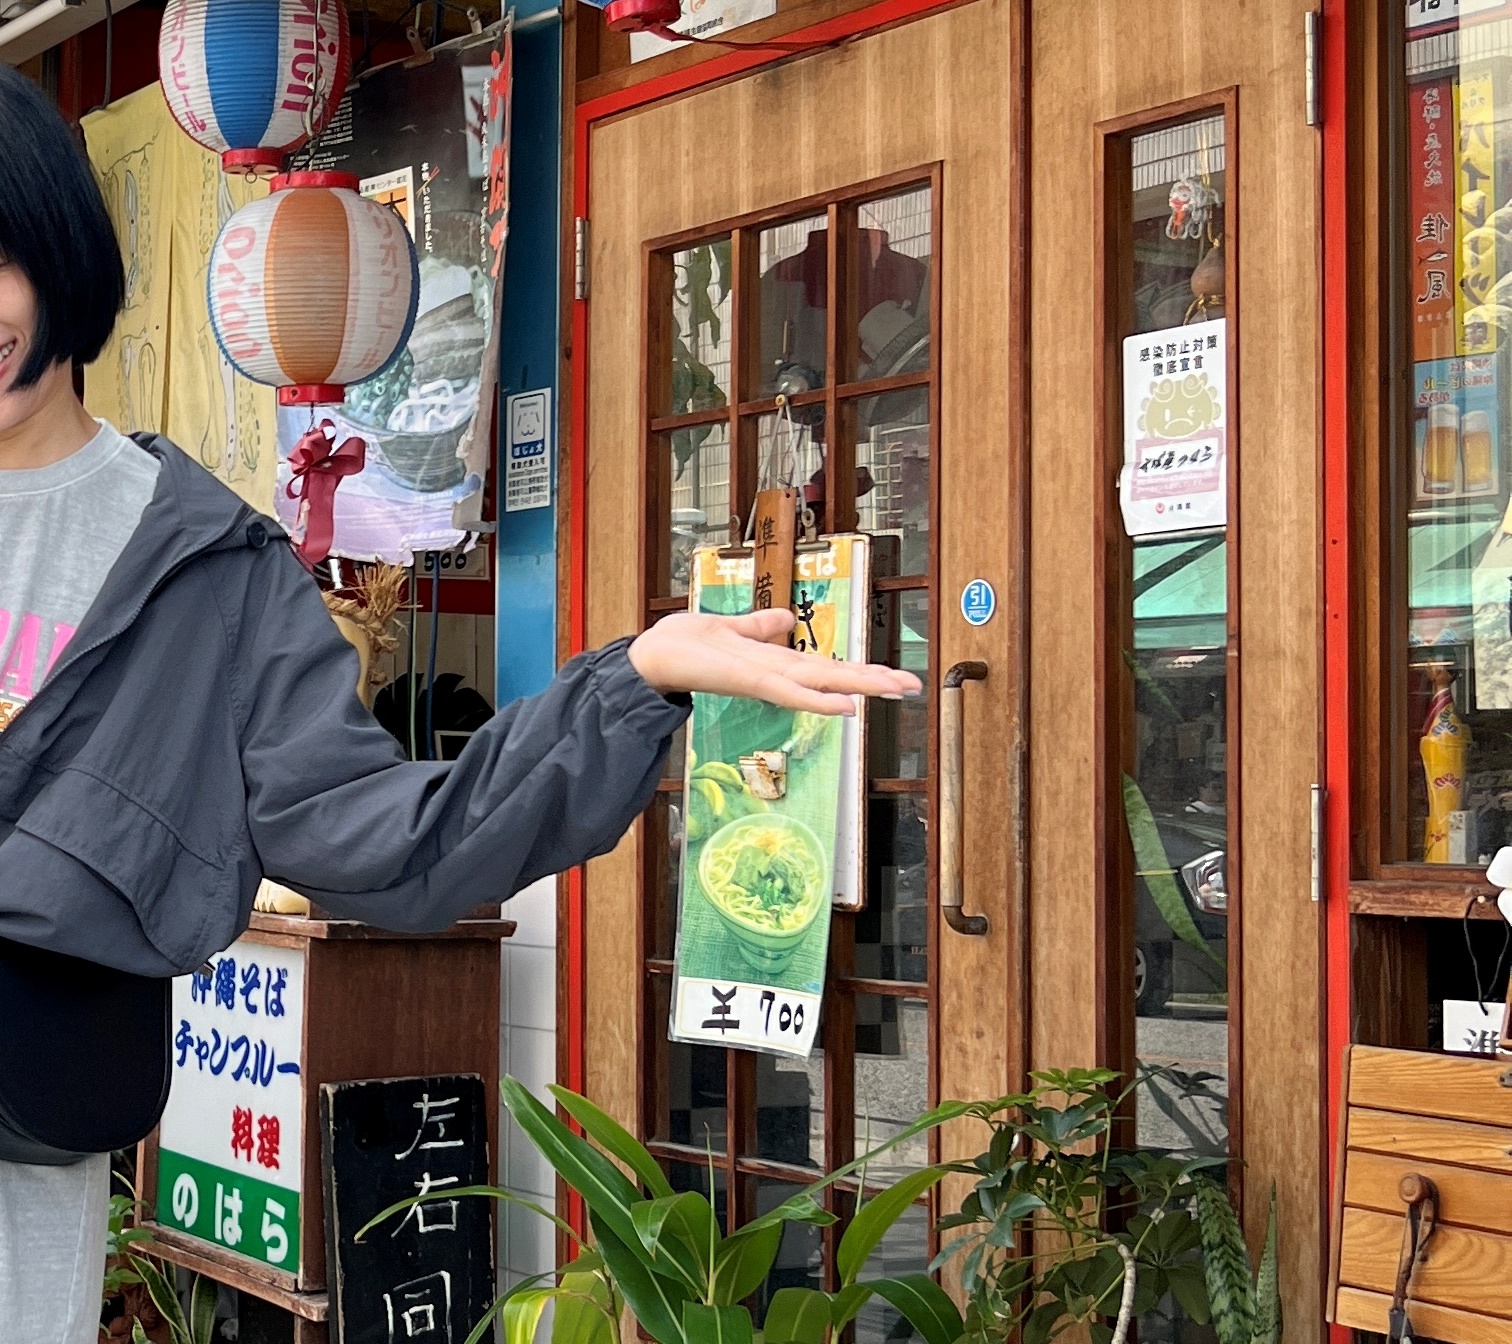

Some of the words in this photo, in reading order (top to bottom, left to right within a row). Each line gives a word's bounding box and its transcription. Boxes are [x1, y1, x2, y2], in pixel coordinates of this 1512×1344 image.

[217, 226, 262, 360] Orion
[1139, 335, 1218, 362] 感染防止対策
[1153, 354, 1204, 377] 徹底宣言
[970, 585, 986, 606] 引
[191, 955, 288, 1018] 沖縄そば
[760, 990, 805, 1036] 700
[175, 1018, 300, 1087] チャンプルー
[231, 1105, 281, 1171] 料理
[172, 1172, 288, 1264] のはら
